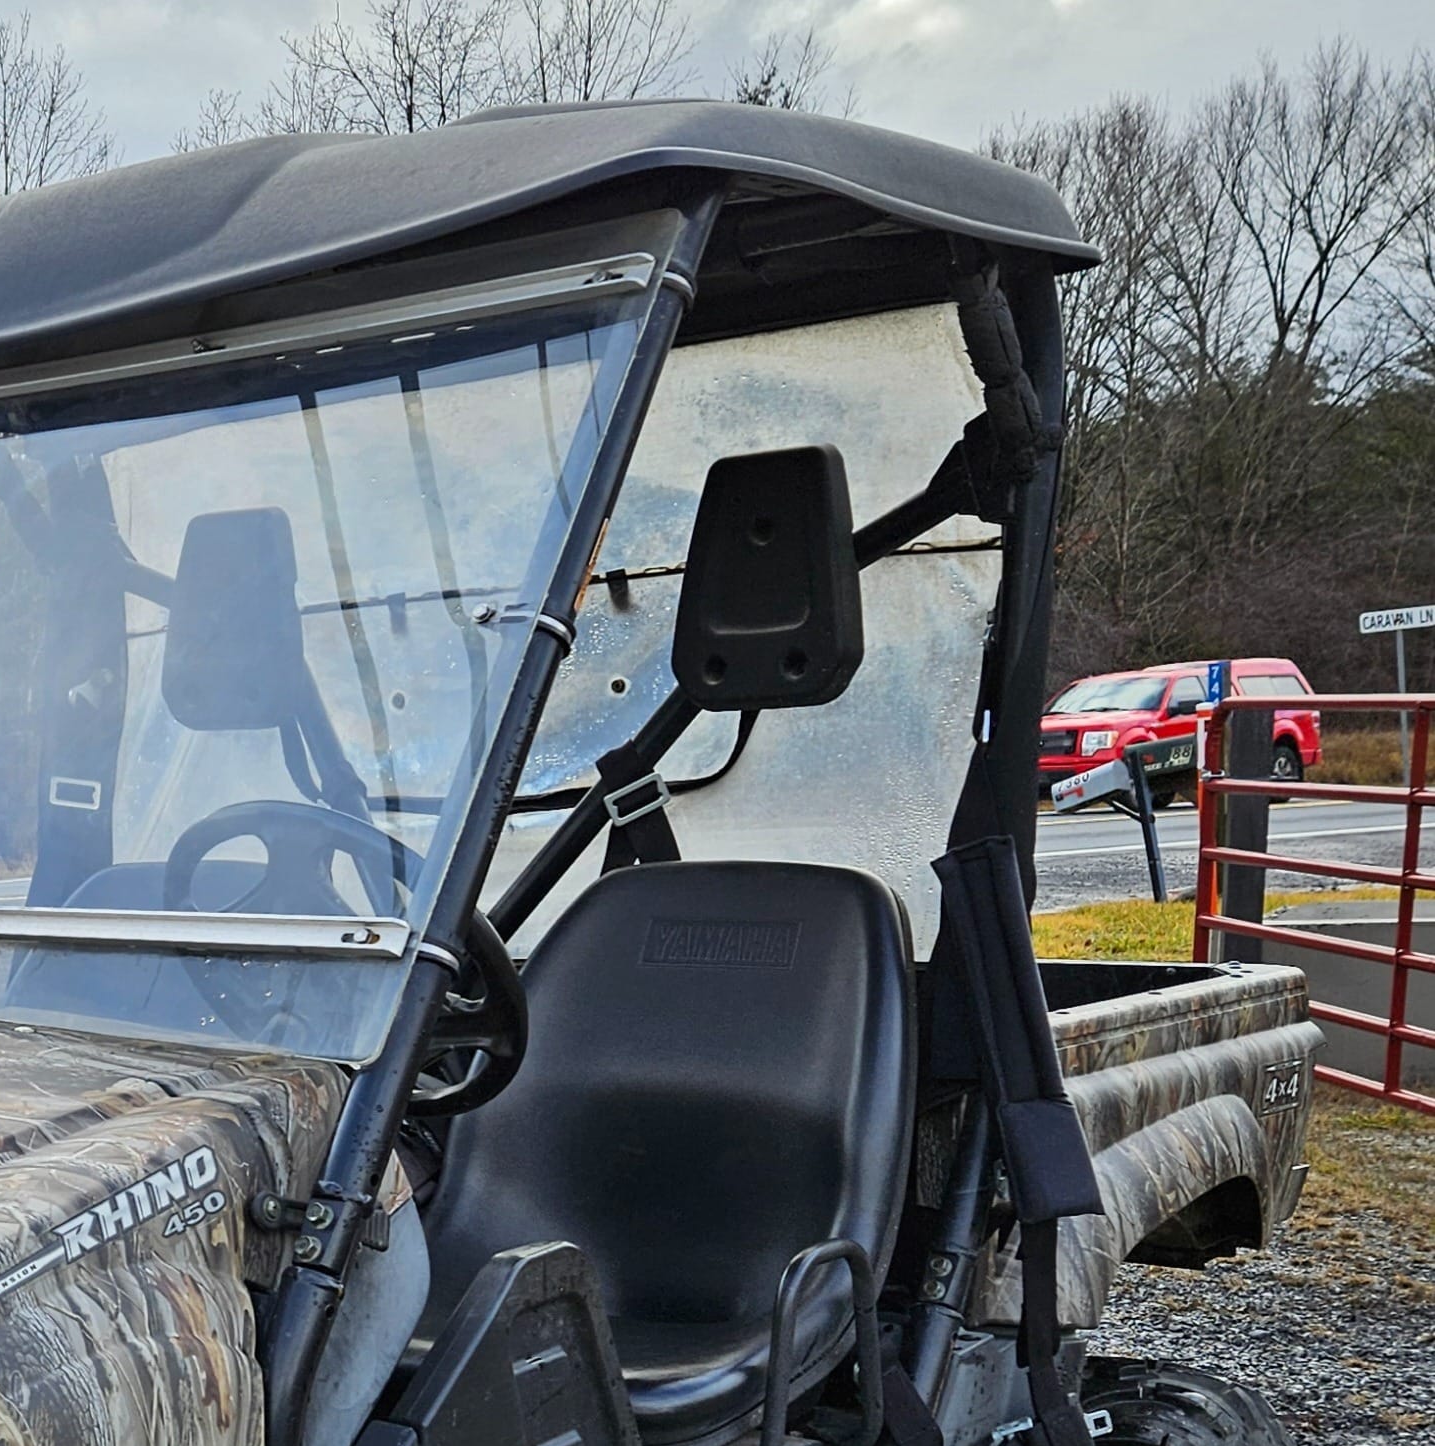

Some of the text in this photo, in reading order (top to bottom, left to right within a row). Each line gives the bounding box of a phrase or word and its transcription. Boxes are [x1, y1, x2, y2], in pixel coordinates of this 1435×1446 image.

[1363, 609, 1433, 630] CARAVAN LN
[53, 1144, 218, 1264] RHINO
[162, 1190, 227, 1238] 450
